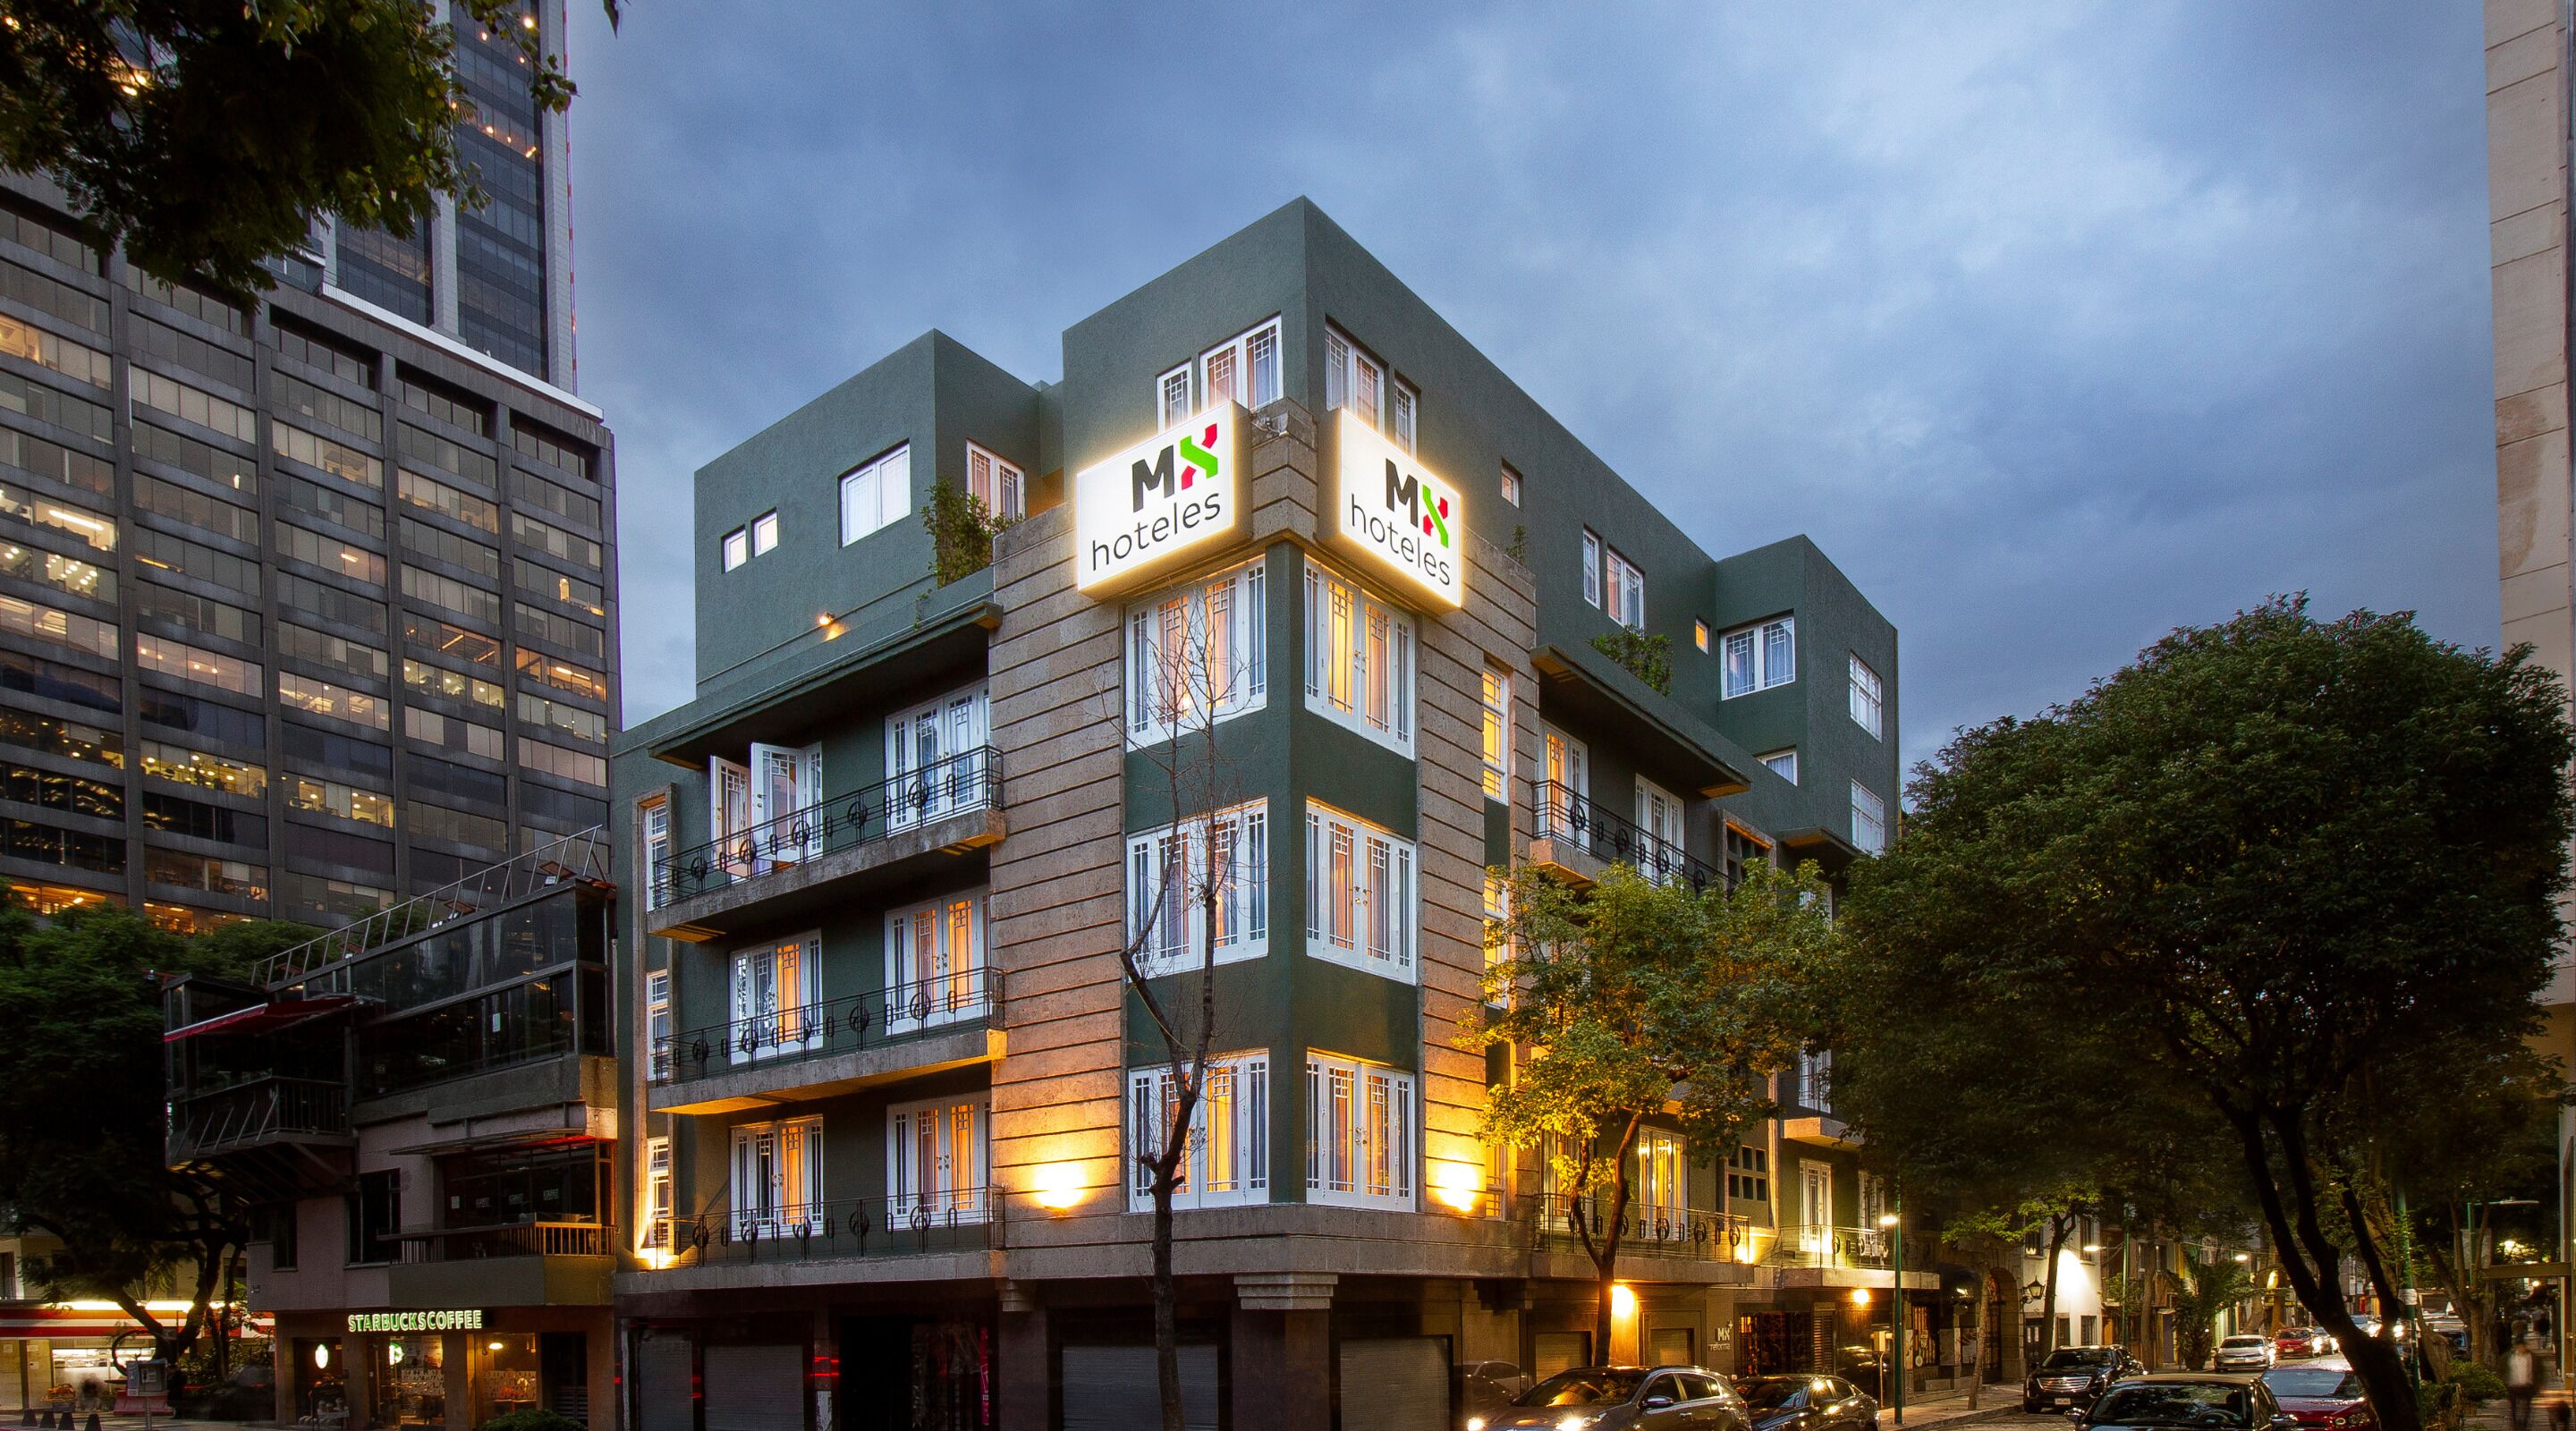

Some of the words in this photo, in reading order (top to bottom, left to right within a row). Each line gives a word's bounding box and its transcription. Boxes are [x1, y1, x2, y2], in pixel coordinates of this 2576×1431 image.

[1131, 422, 1218, 513] MX
[1385, 457, 1449, 549] MX
[1091, 492, 1222, 572] hoteles
[1351, 493, 1451, 587] hoteles
[347, 1312, 426, 1333] STARBUCKS
[427, 1309, 482, 1330] COFFEE
